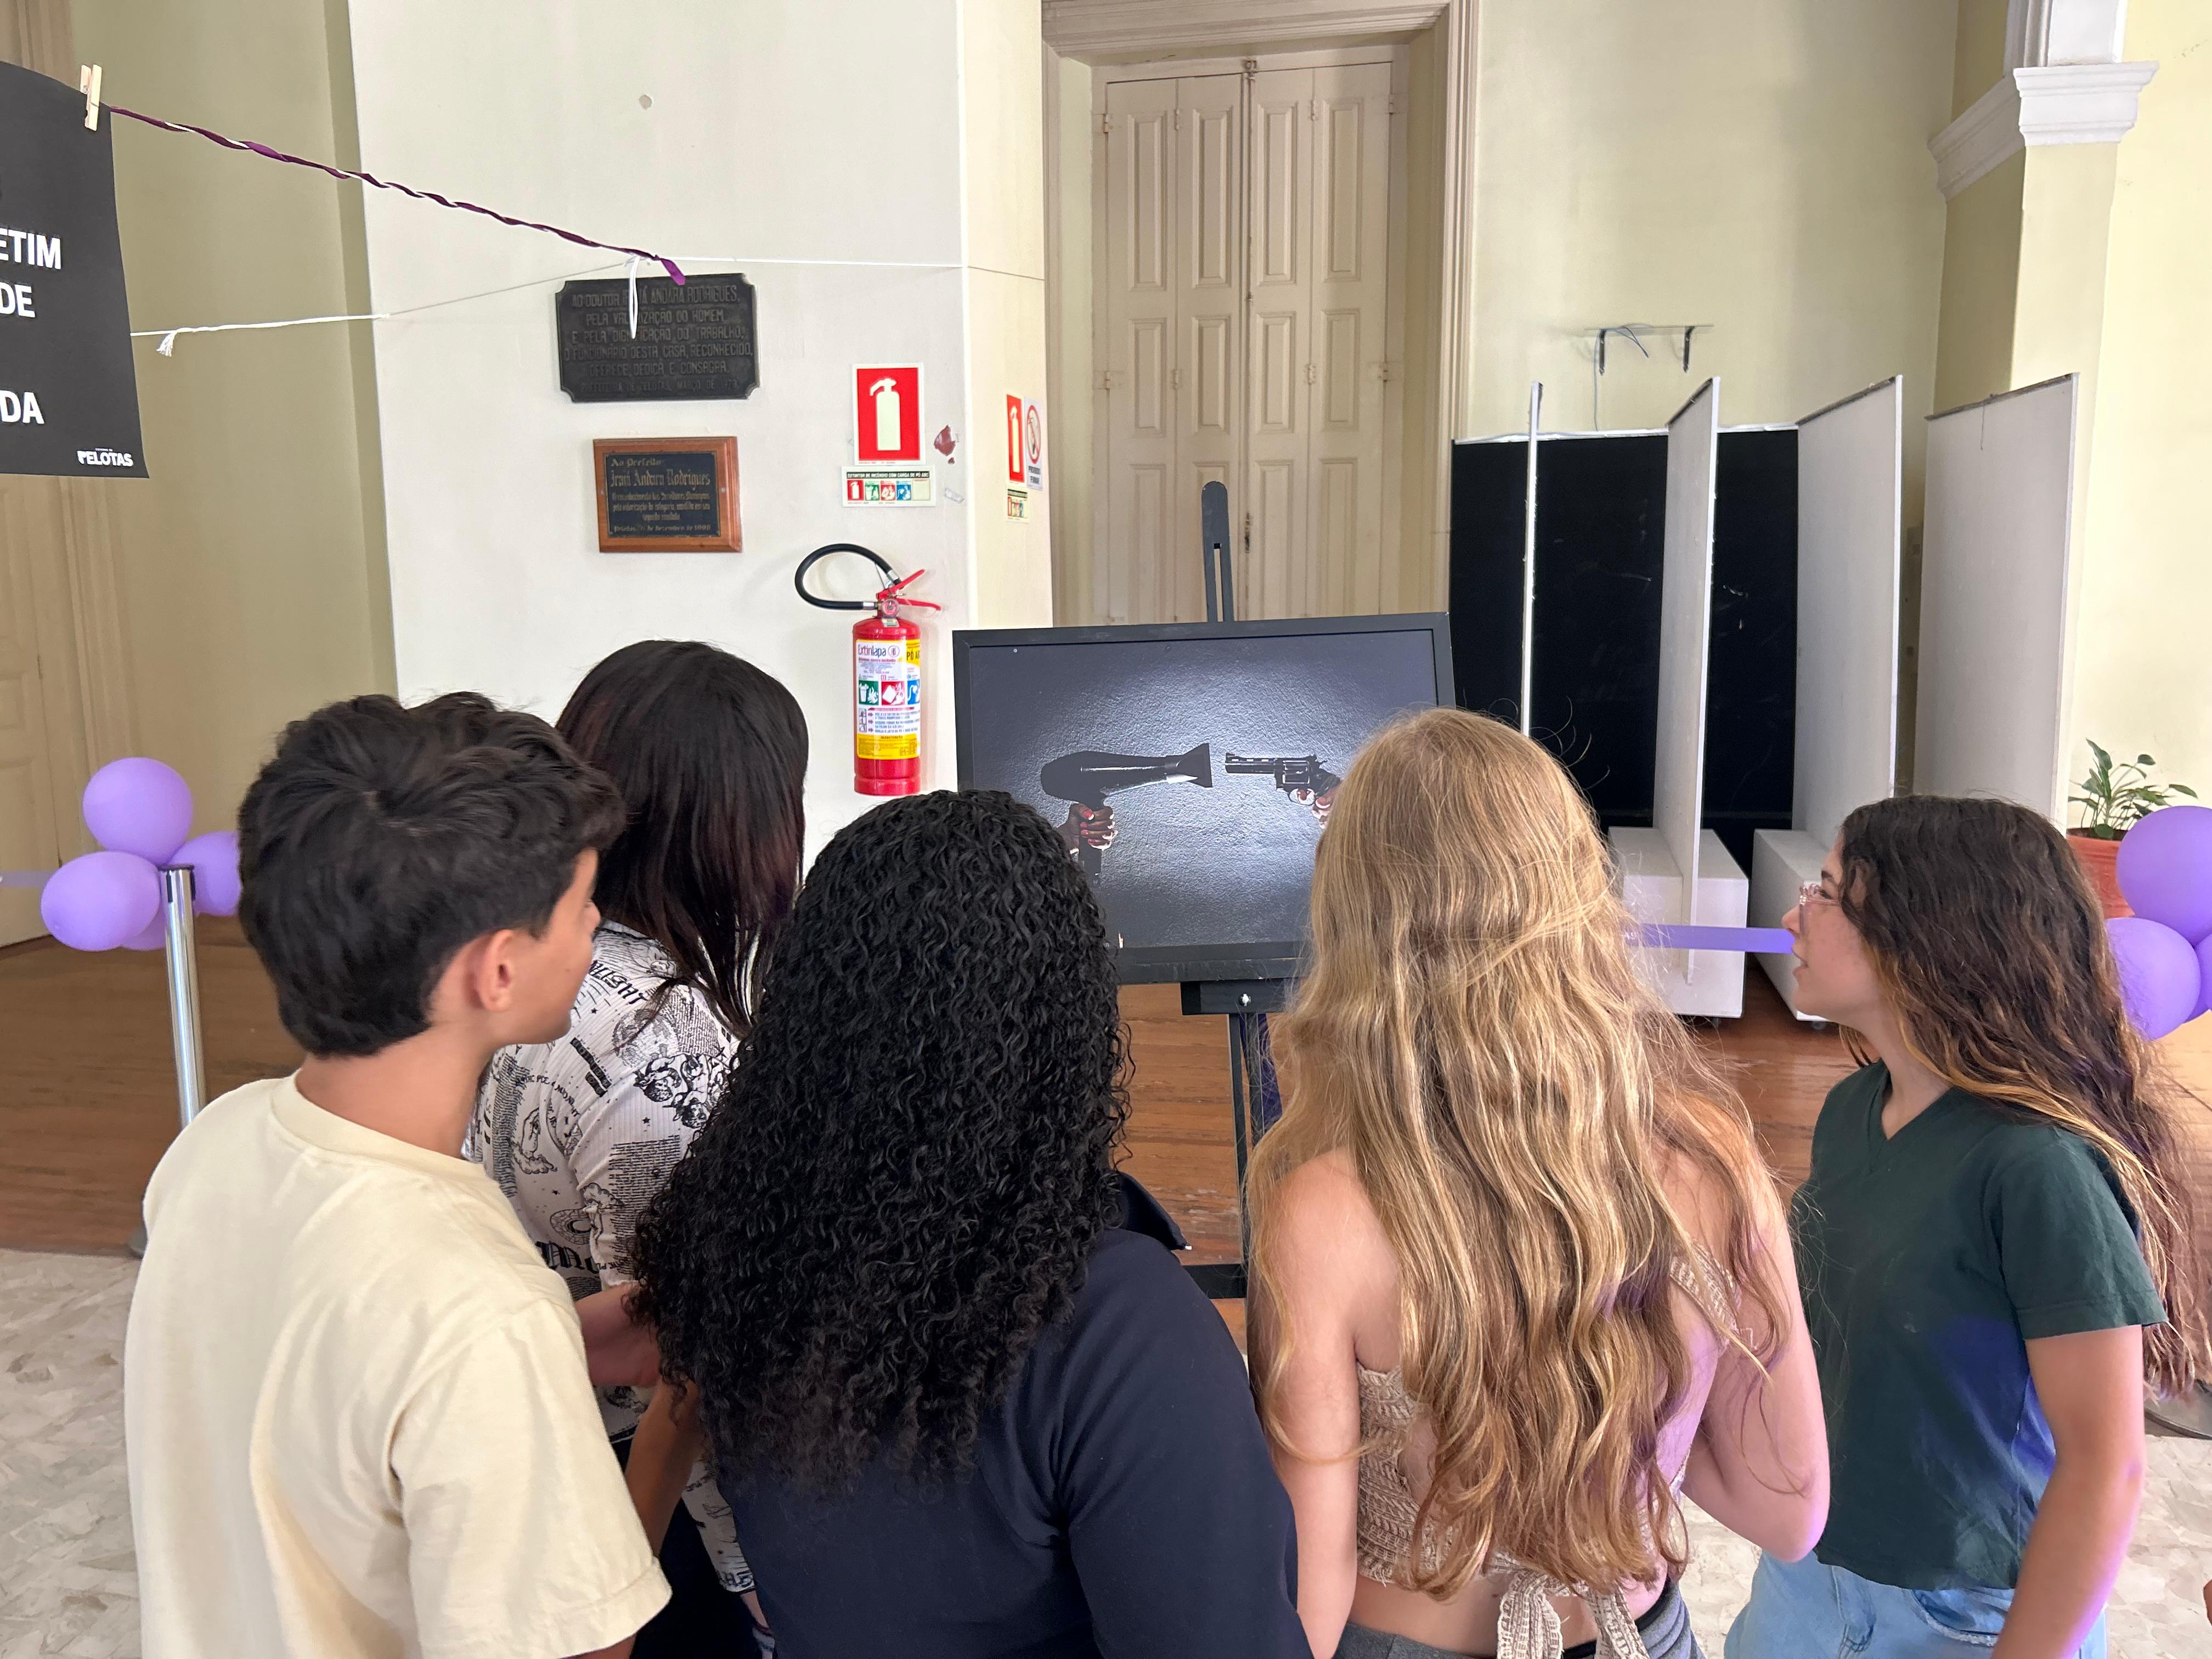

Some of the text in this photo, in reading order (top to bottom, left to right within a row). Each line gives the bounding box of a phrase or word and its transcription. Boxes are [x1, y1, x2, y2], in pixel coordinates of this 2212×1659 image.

[0, 281, 35, 318] DE
[0, 390, 44, 424] DA
[77, 450, 133, 466] PELOTAS
